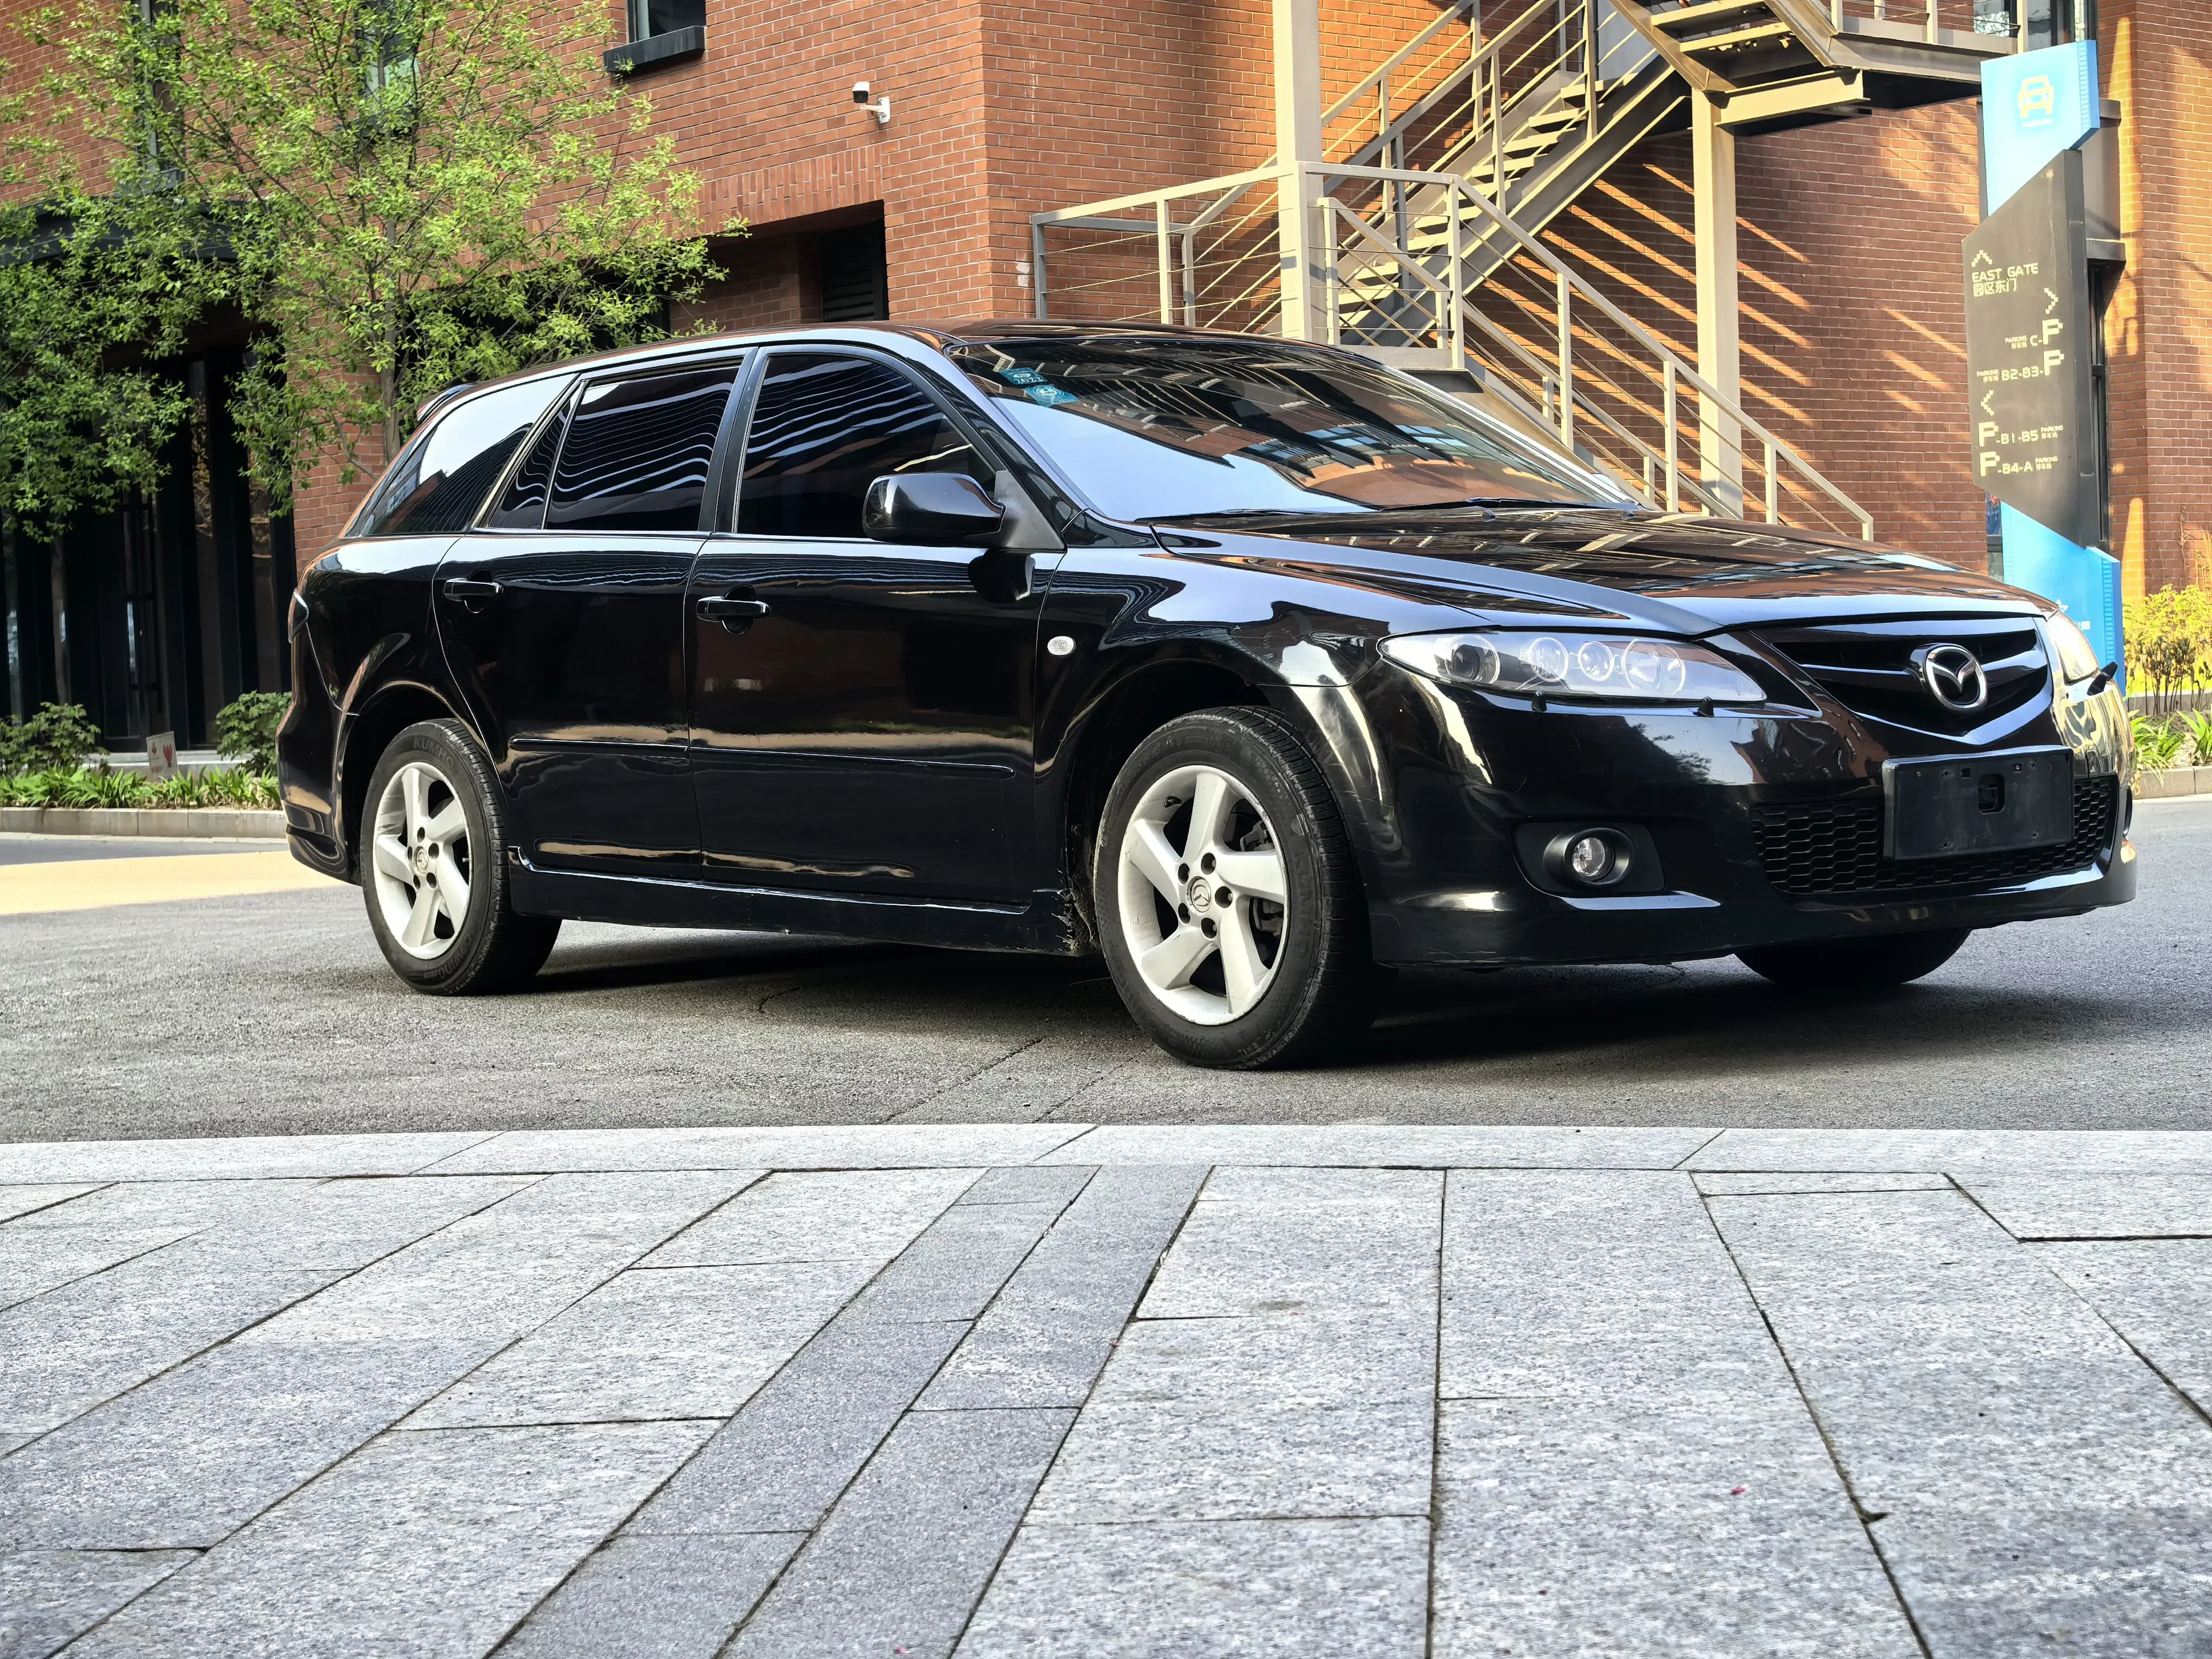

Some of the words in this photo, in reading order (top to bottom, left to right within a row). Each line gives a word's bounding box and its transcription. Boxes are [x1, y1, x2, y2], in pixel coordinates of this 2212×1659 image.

[1972, 268, 2002, 283] EAST
[2007, 262, 2039, 278] GATE
[1973, 278, 2017, 298] 园区东门
[414, 736, 454, 768] KUMHO
